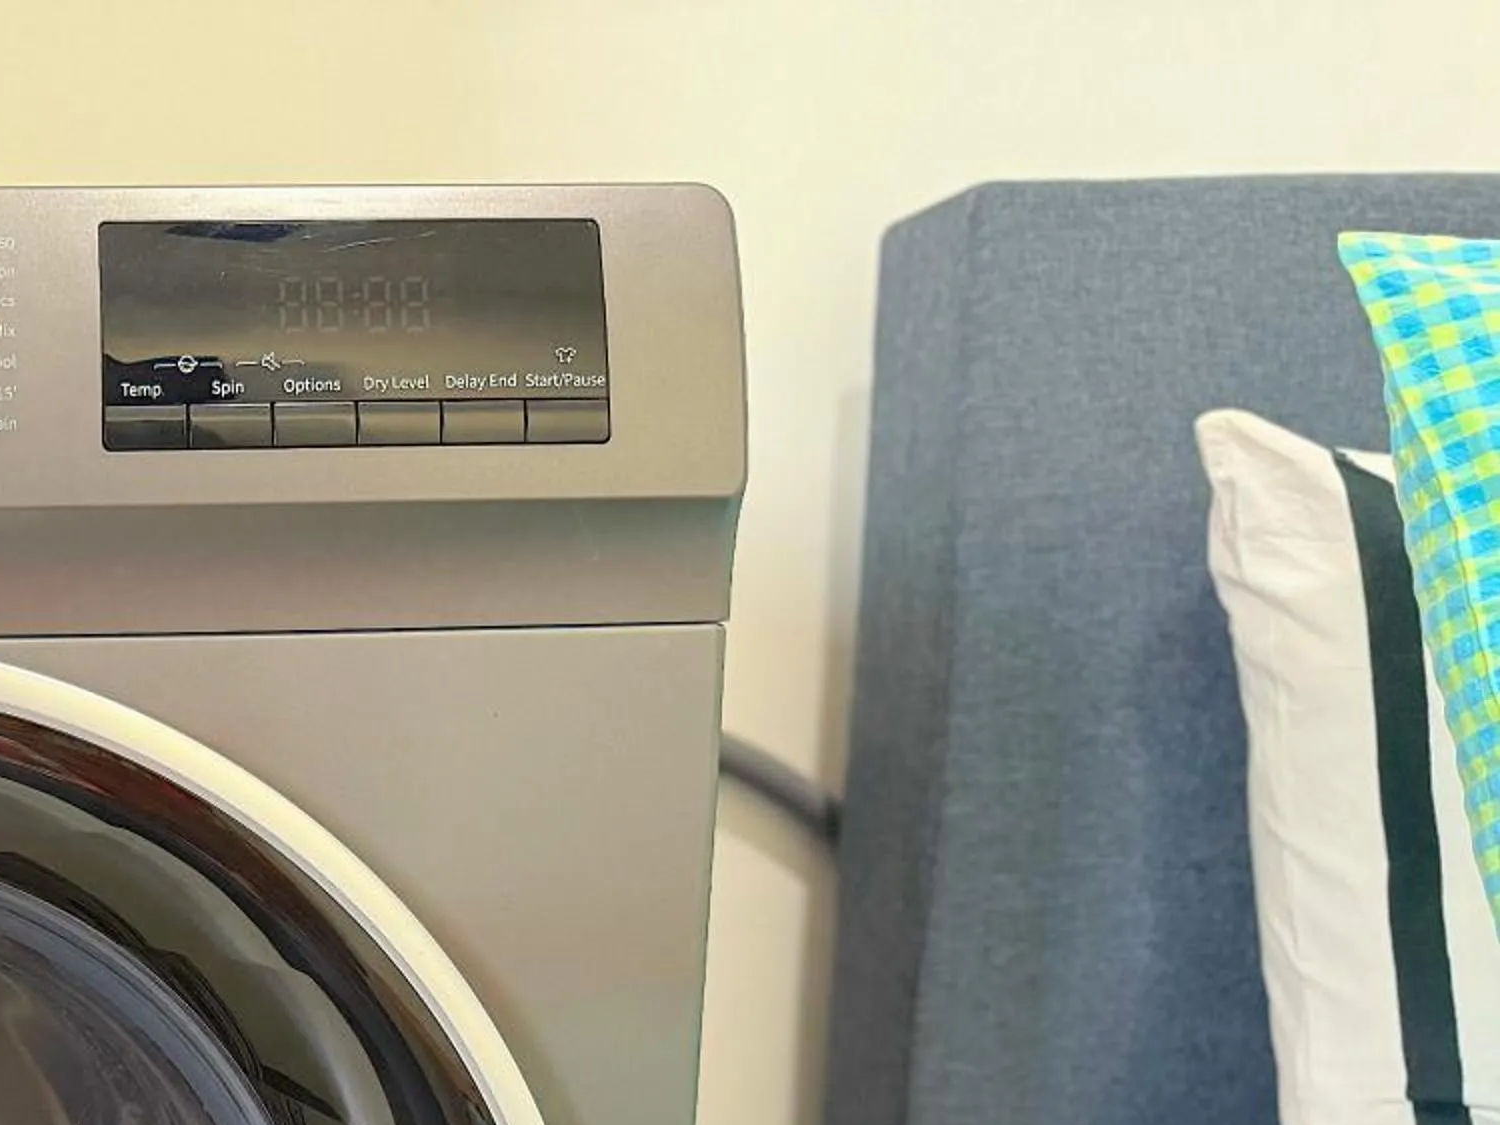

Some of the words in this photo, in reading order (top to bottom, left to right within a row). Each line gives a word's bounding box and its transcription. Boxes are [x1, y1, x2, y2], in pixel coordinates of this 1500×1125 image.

[211, 380, 245, 396] Spin
[283, 378, 341, 395] Options
[363, 376, 390, 392] Dry
[392, 375, 430, 390] Level
[445, 374, 487, 391] Delay
[489, 373, 517, 388] End
[525, 372, 606, 388] Start/Pause
